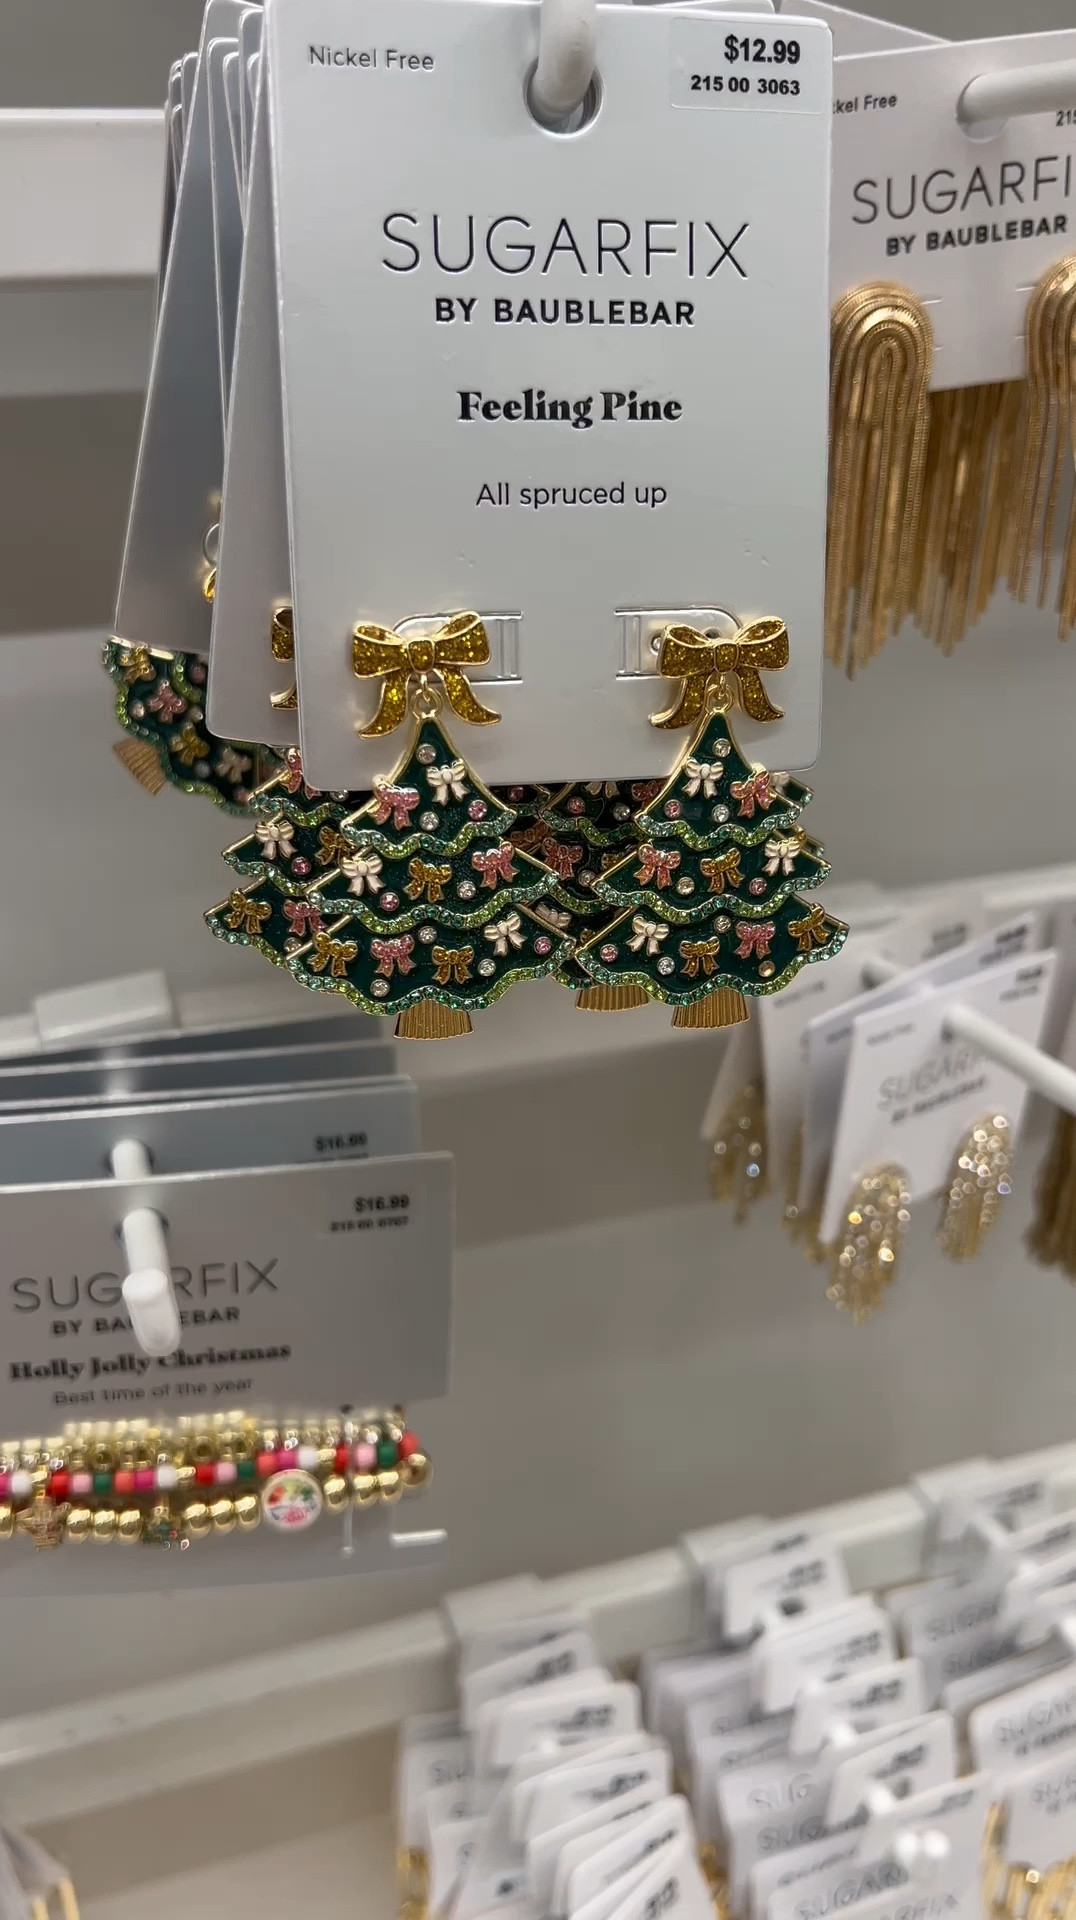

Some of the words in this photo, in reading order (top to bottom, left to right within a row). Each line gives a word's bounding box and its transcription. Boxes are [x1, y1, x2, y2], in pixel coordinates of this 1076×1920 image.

[309, 45, 377, 68] Nickel
[384, 48, 434, 72] Free
[723, 34, 801, 64] $12.99
[690, 74, 724, 92] 215
[727, 76, 750, 94] 00
[757, 78, 801, 96] 3063
[832, 96, 859, 114] kel
[863, 94, 898, 111] Free
[382, 213, 750, 279] SUGARFIX
[885, 234, 916, 257] BY
[925, 214, 1069, 252] BAUBLEBAR
[435, 297, 478, 323] BY
[494, 299, 695, 326] BAUBLEBAR
[456, 389, 594, 429] Feeling
[600, 391, 683, 422] Pine
[475, 482, 510, 506] All
[519, 482, 625, 510] spruced
[633, 487, 668, 509] up
[10, 1257, 280, 1315] SUGRFIX
[51, 1319, 84, 1336] BY
[93, 1306, 240, 1334] BAEBAR
[10, 1357, 84, 1381] Holly
[90, 1353, 151, 1377] Jolly
[156, 1344, 292, 1369] Christmas
[53, 1390, 95, 1406] Best
[102, 1386, 146, 1403] time
[152, 1382, 171, 1398] of
[176, 1379, 208, 1397] the
[213, 1378, 253, 1396] year
